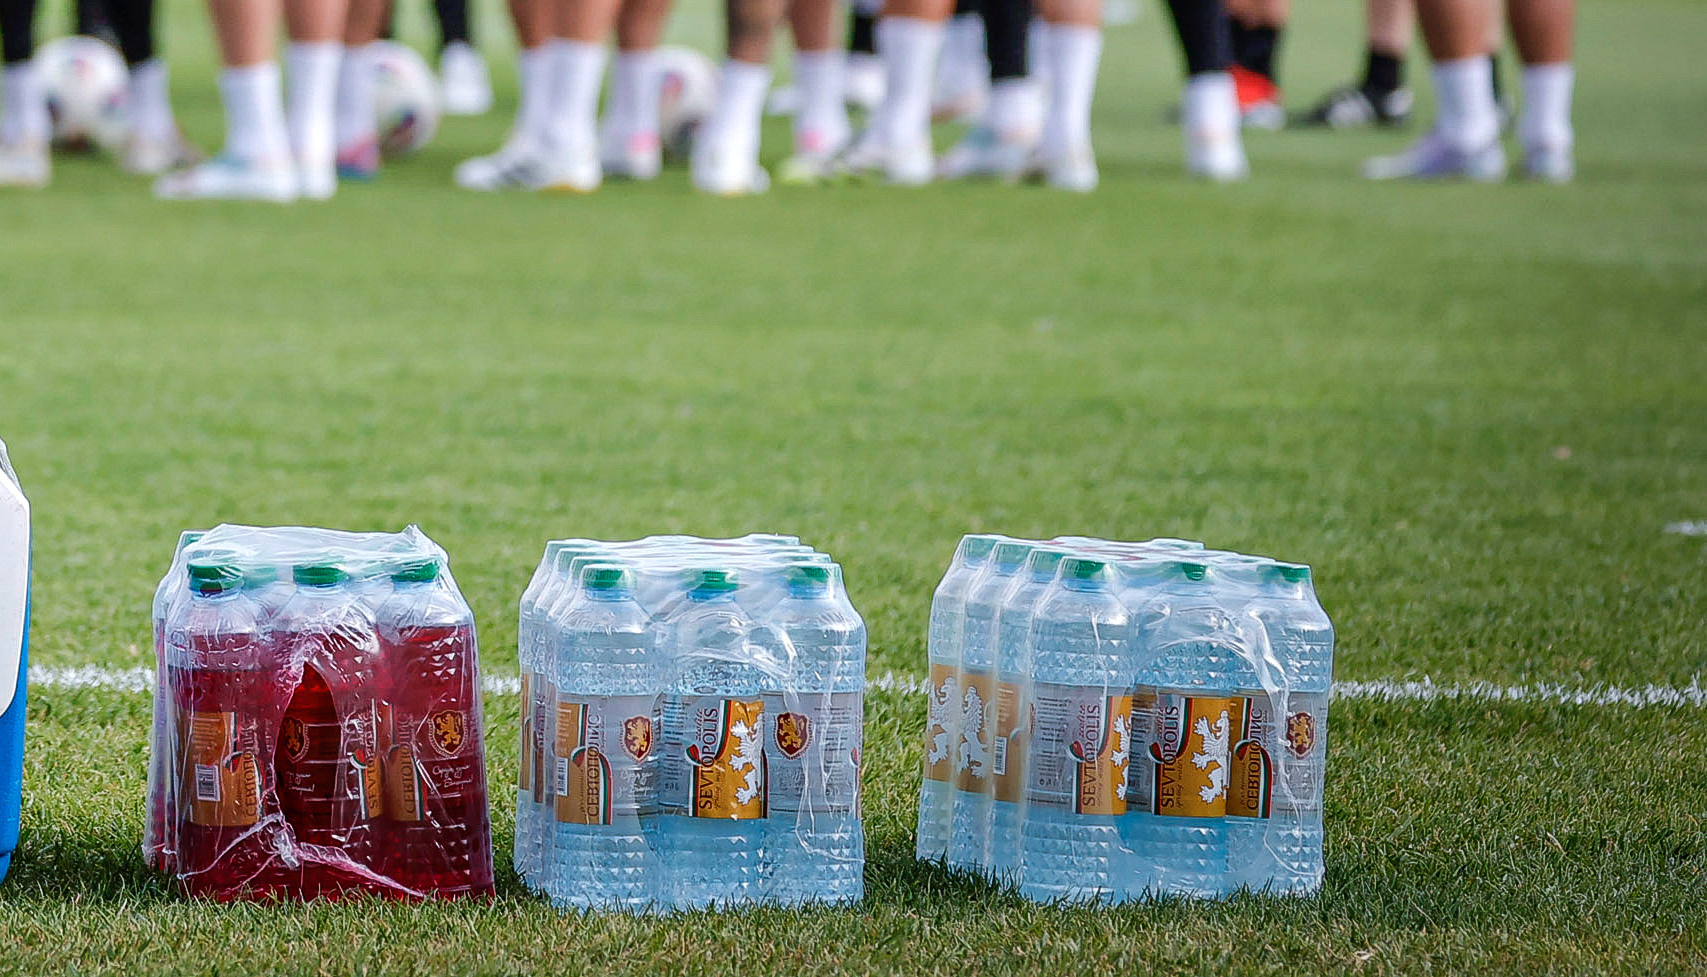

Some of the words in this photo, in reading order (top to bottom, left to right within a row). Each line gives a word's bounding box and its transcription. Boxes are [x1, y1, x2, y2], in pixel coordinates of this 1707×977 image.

[586, 714, 600, 817] СЕВТОПОЛИС
[699, 708, 719, 810] SEVTOPOLIS
[1082, 705, 1100, 807] SEVTOPOLIS
[1161, 705, 1179, 809] SEVTOPOLIS
[1246, 708, 1263, 810] СЕВТОПОЛИС
